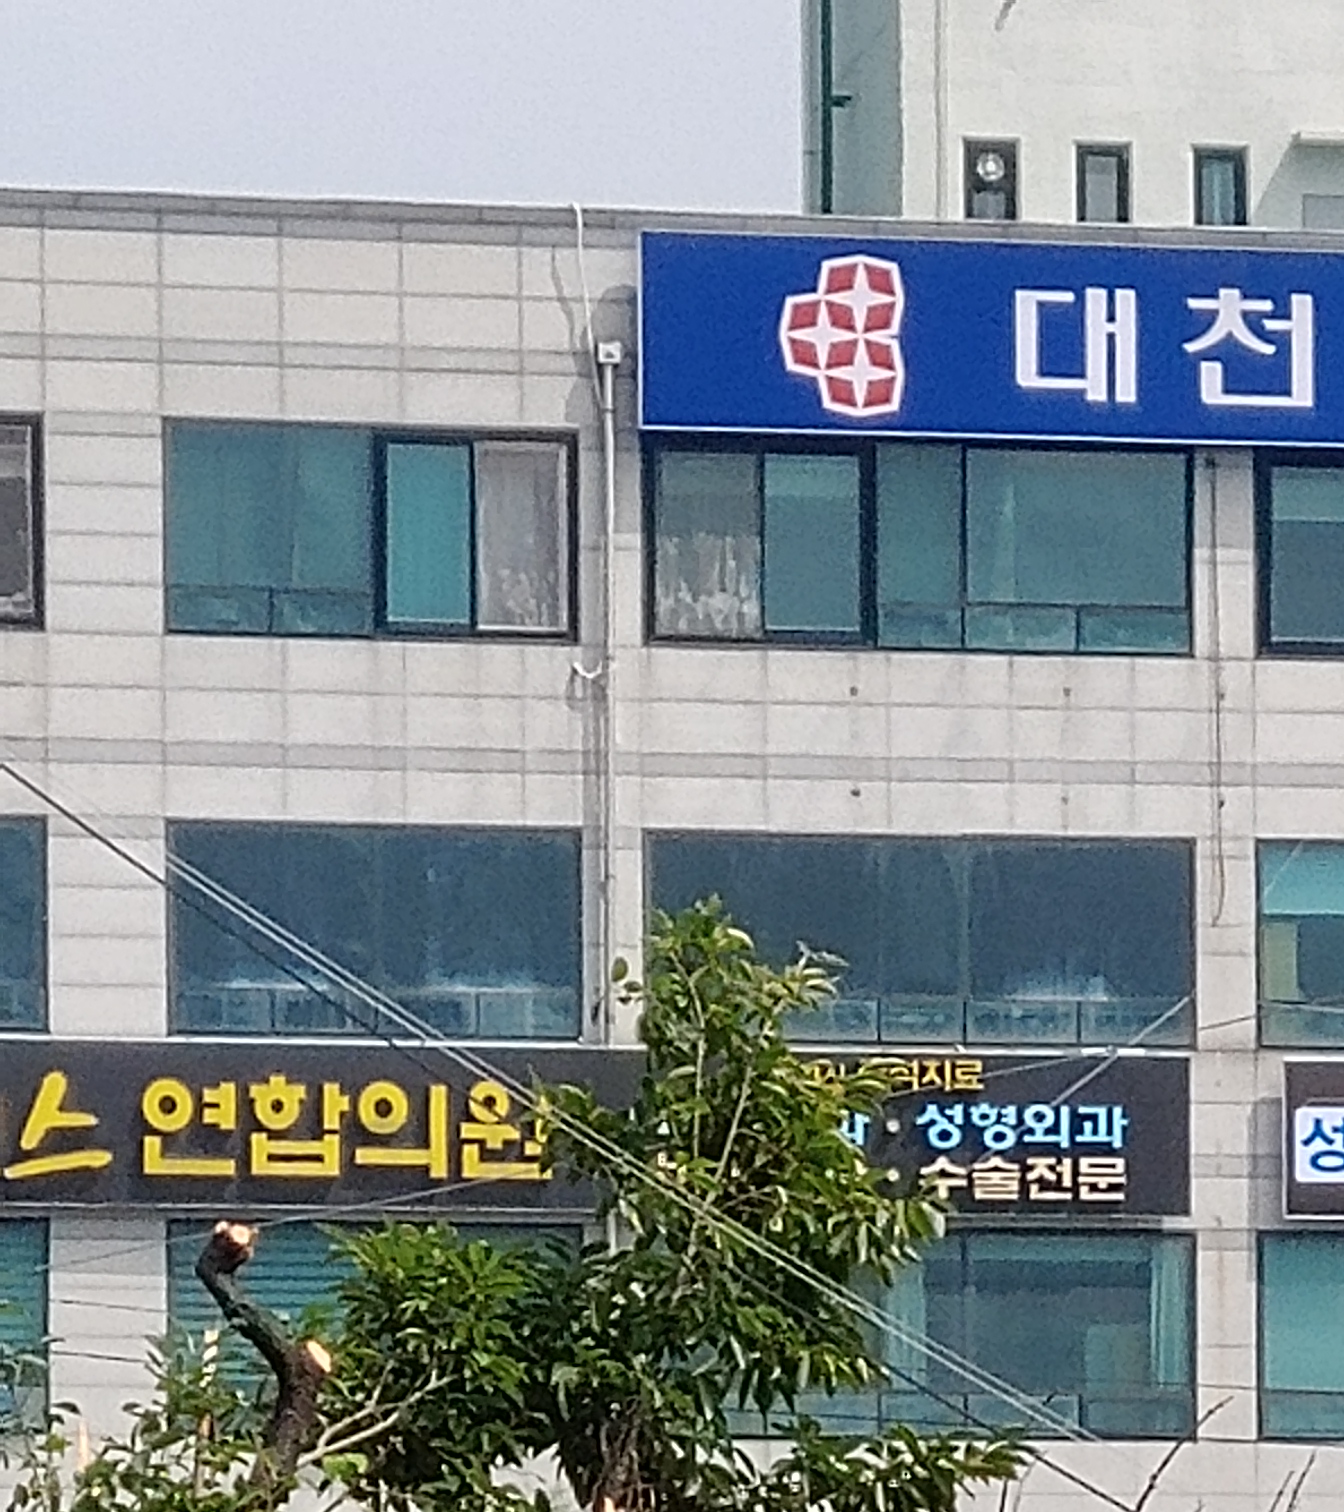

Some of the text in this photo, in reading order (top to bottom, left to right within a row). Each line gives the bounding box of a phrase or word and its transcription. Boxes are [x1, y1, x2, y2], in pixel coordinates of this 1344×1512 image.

[142, 1075, 554, 1180] 연합의원
[915, 1103, 1129, 1150] 성형외과
[918, 1155, 1127, 1201] 수술전문
